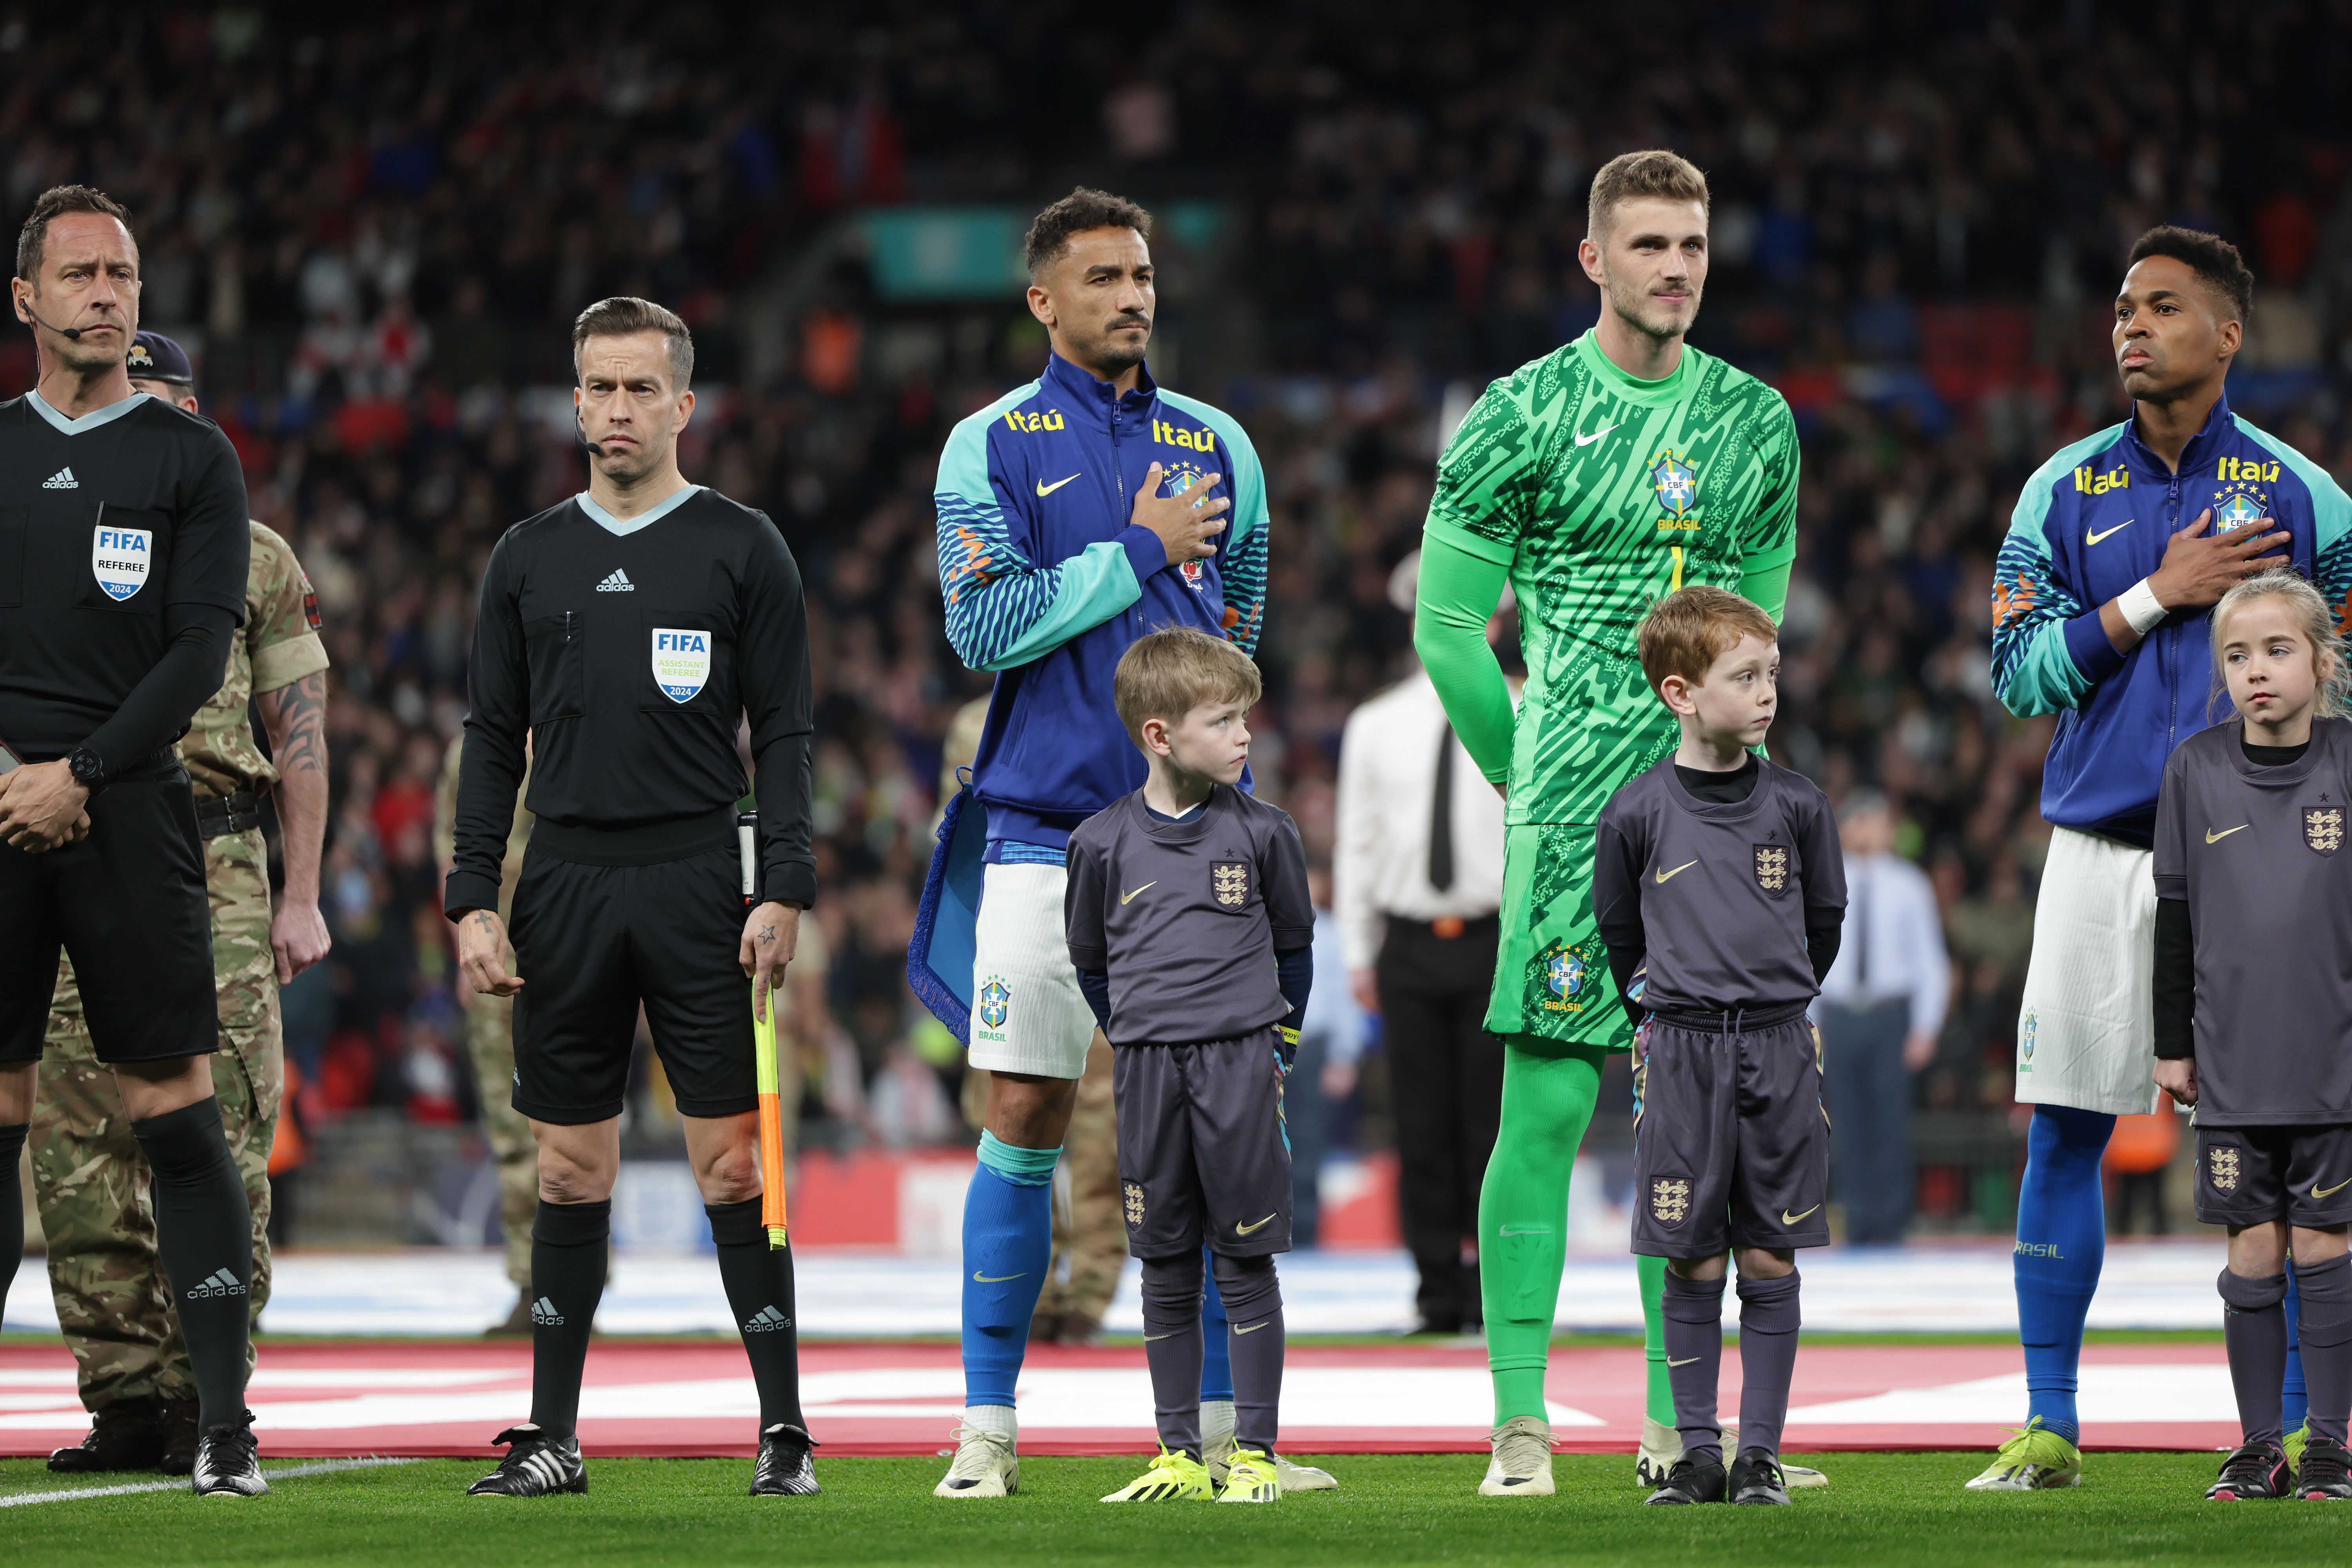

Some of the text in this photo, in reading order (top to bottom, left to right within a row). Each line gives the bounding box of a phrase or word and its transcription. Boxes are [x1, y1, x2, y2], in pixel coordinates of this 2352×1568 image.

[1003, 409, 1065, 433] Itaú
[1153, 419, 1214, 452] Itaú
[2218, 457, 2280, 483] Itaú
[42, 480, 79, 489] adidas
[2074, 464, 2129, 495] Itaú
[1657, 519, 1701, 530] BRASIL
[100, 531, 146, 552] FIFA
[98, 559, 145, 572] REFEREE
[109, 584, 131, 594] 2024
[596, 583, 635, 592] adidas
[659, 633, 706, 652] FIFA
[658, 659, 705, 668] ASSISTANT
[662, 668, 701, 677] REFEREE
[670, 687, 691, 696] 2024
[1544, 1001, 1584, 1012] BRASIL
[978, 1031, 1006, 1042] BRASIL
[1284, 1031, 1297, 1040] Acce
[2013, 1240, 2064, 1259] RASIL
[187, 1283, 246, 1299] adidas
[532, 1314, 564, 1325] didas
[744, 1318, 791, 1333] adidas
